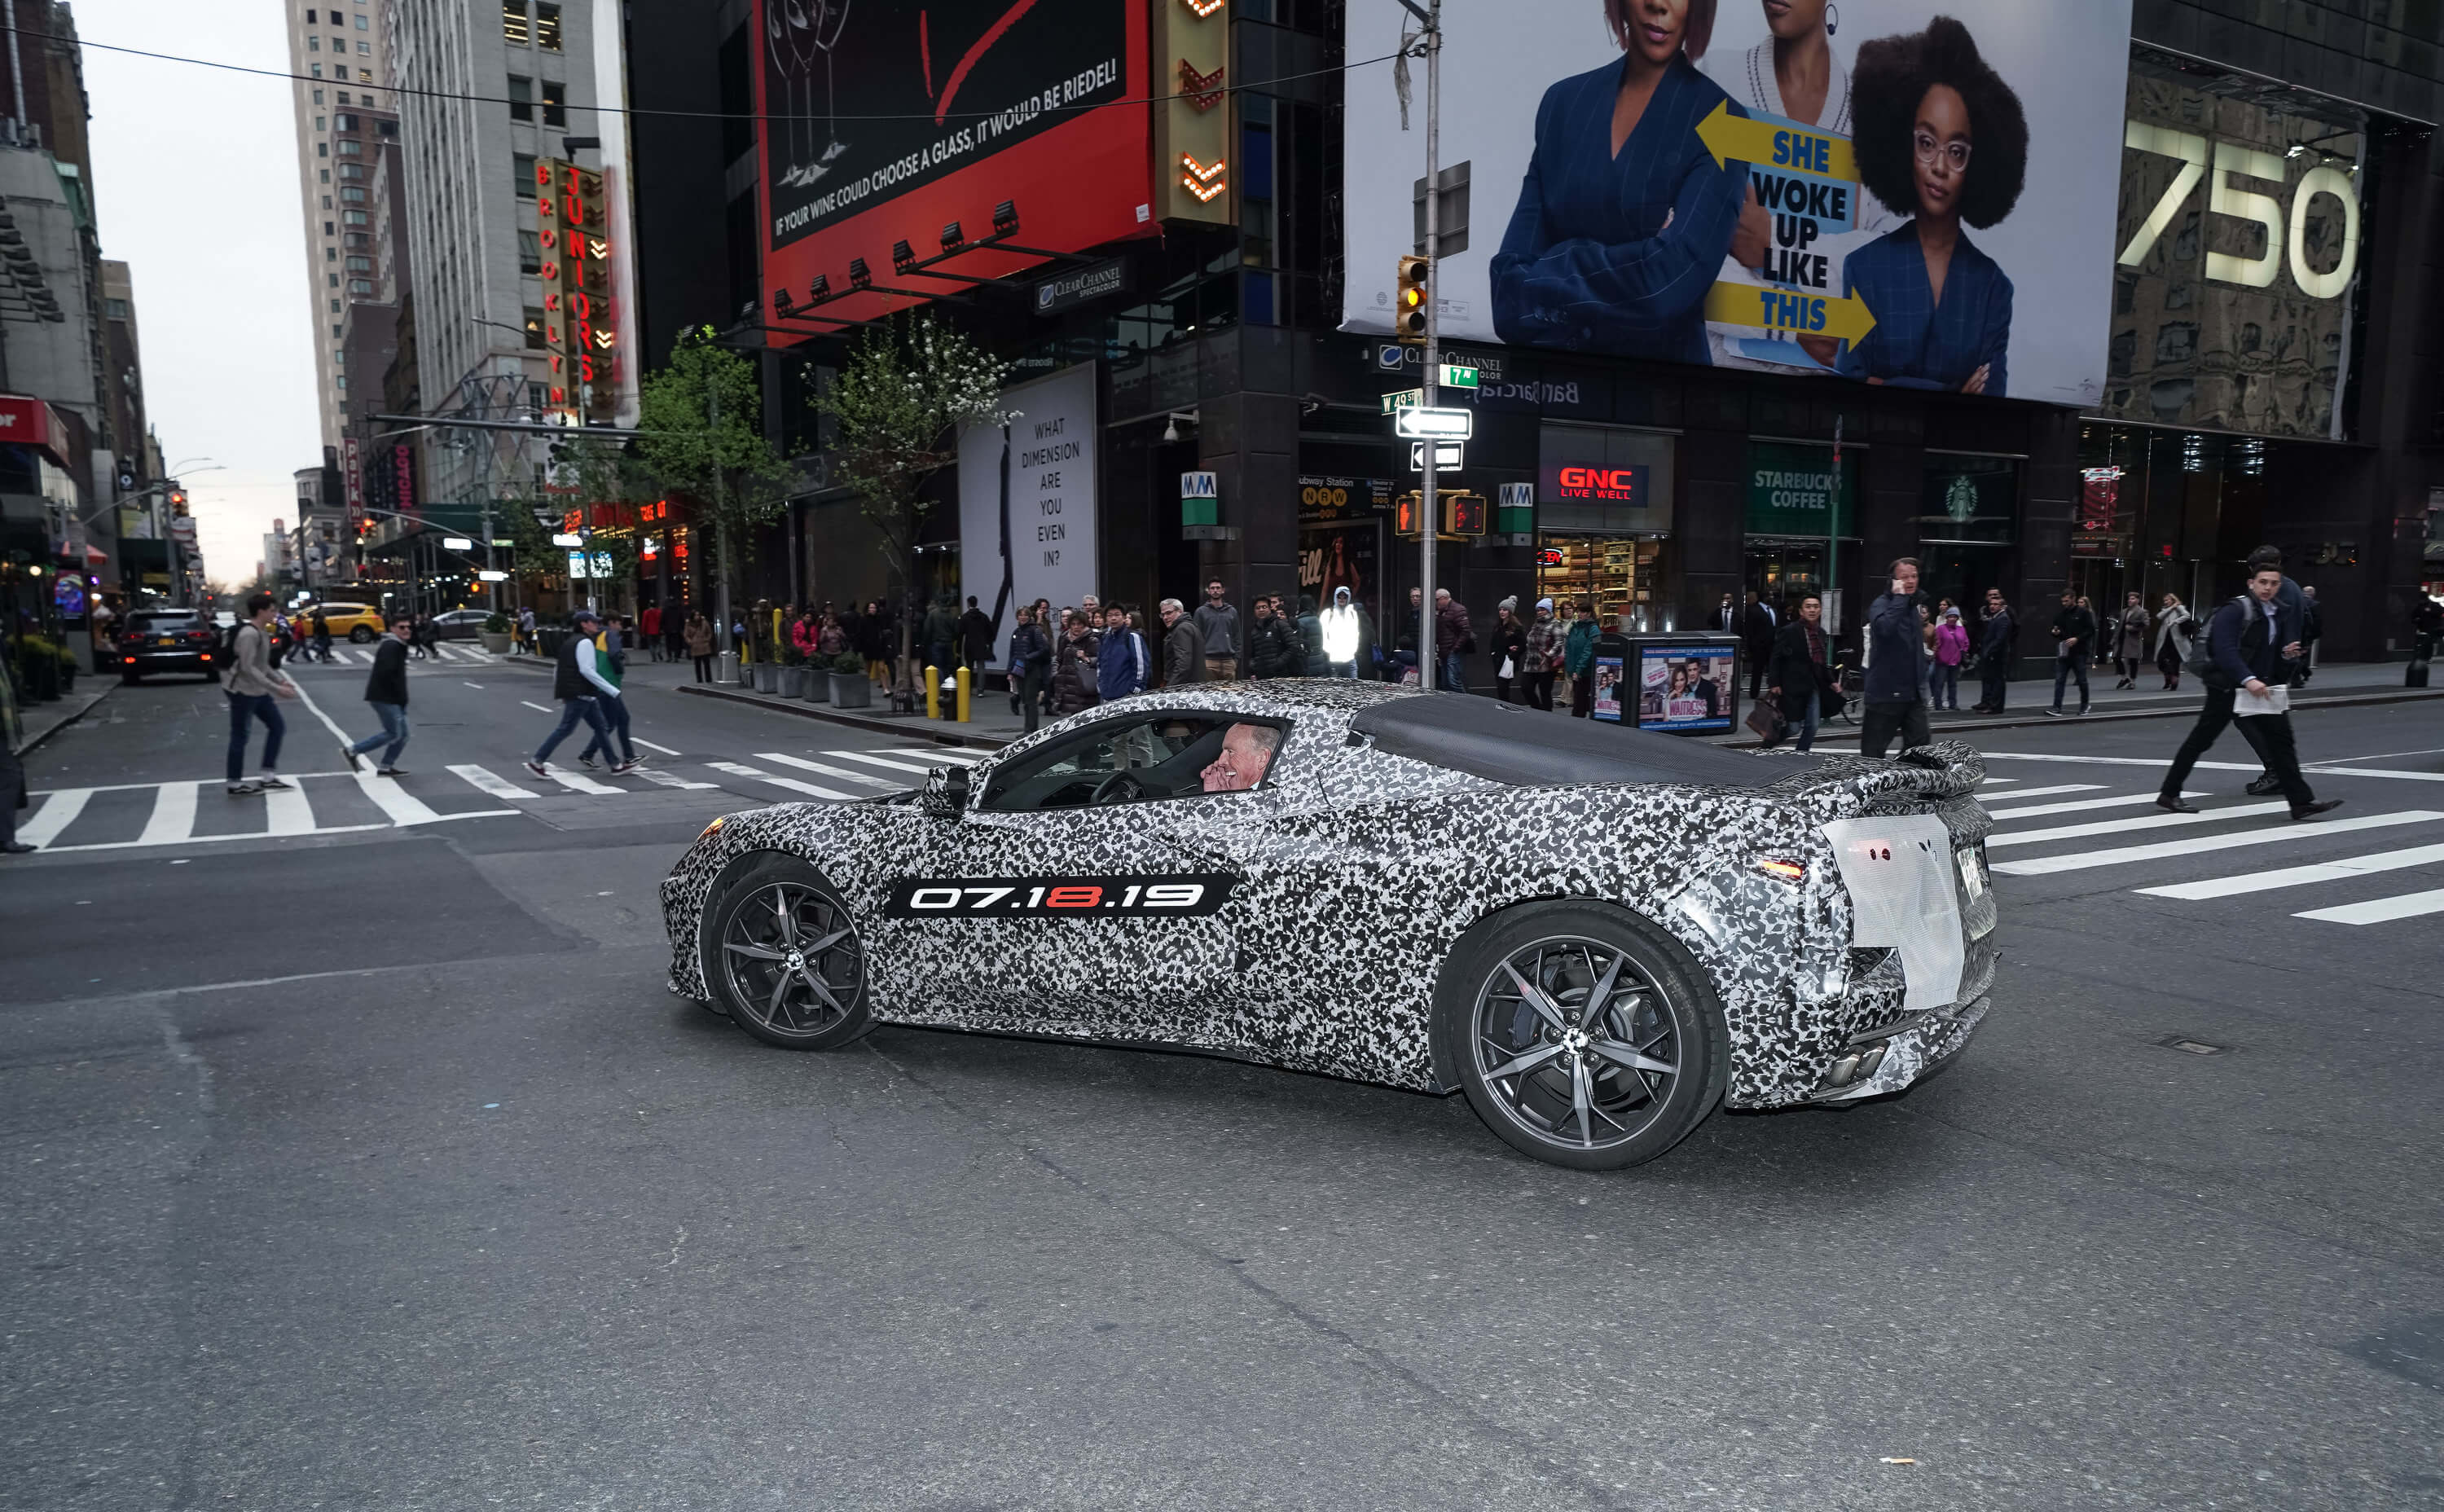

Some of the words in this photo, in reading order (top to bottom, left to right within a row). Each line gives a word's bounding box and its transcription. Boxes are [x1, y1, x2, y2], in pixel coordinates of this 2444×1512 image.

[776, 218, 783, 236] IF
[785, 206, 809, 231] YOUR
[810, 193, 836, 220] WINE
[837, 177, 870, 207] COULD
[872, 153, 919, 191] CHOOSE
[921, 148, 930, 170] A
[932, 128, 974, 163] GLASS,
[978, 121, 987, 143] IT
[990, 96, 1040, 138] WOULD
[1044, 85, 1060, 111] BE
[1064, 59, 1116, 103] RIEDEL!
[1773, 130, 1830, 173] SHE
[1752, 171, 1847, 222] WOKE
[2118, 120, 2359, 299] 750
[1777, 213, 1818, 250] UP
[1763, 248, 1828, 288] LIKE
[537, 165, 563, 402] BROOKLYN
[1079, 279, 1120, 297] SPECTACOLOR
[1760, 291, 1826, 332] THIS
[1453, 368, 1461, 385] 7
[1383, 398, 1391, 412] W
[1395, 394, 1406, 407] 49
[1408, 393, 1415, 401] ST
[1035, 418, 1065, 440] WHAT
[1022, 441, 1080, 468] DIMENSION
[396, 445, 412, 509] HICAGO
[1040, 472, 1062, 490] ARE
[1299, 477, 1324, 487] ubway
[1326, 477, 1353, 487] Station
[1559, 467, 1633, 490] GNC
[1561, 489, 1590, 498] LIVE
[1597, 490, 1631, 499] WELL
[1771, 490, 1826, 508] COFFEE
[1040, 498, 1062, 516] YOU
[1038, 524, 1066, 542] EVEN
[1044, 551, 1060, 567] IN?
[910, 884, 1204, 908] 07.18.19
